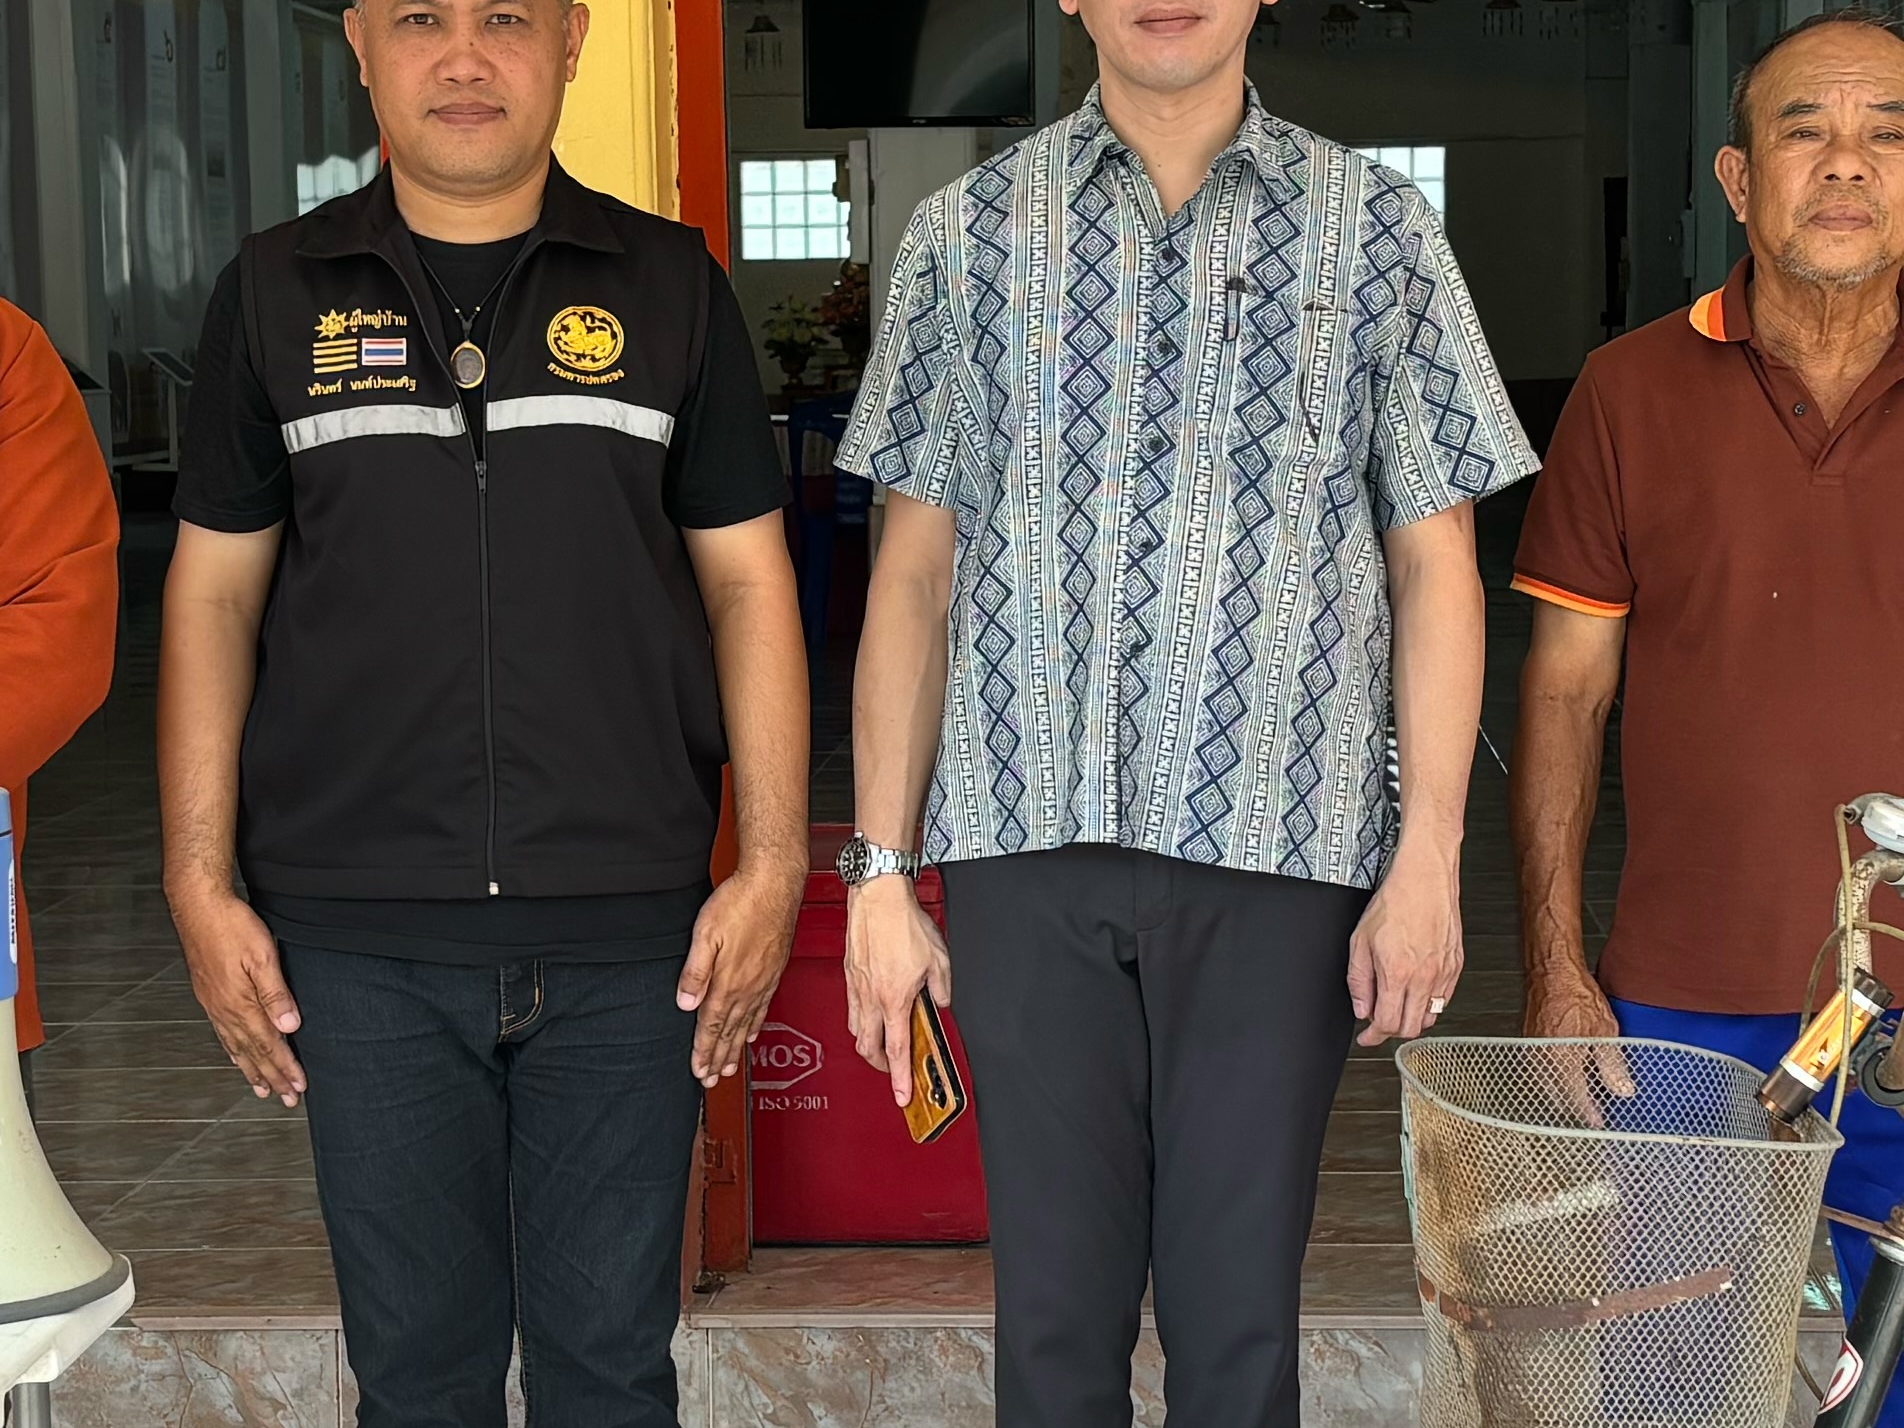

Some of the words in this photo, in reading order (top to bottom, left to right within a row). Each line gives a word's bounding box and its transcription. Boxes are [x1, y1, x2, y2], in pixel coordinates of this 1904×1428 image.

[348, 307, 408, 334] ผู้ใหญ่บ้าน
[758, 1095, 791, 1111] ISO
